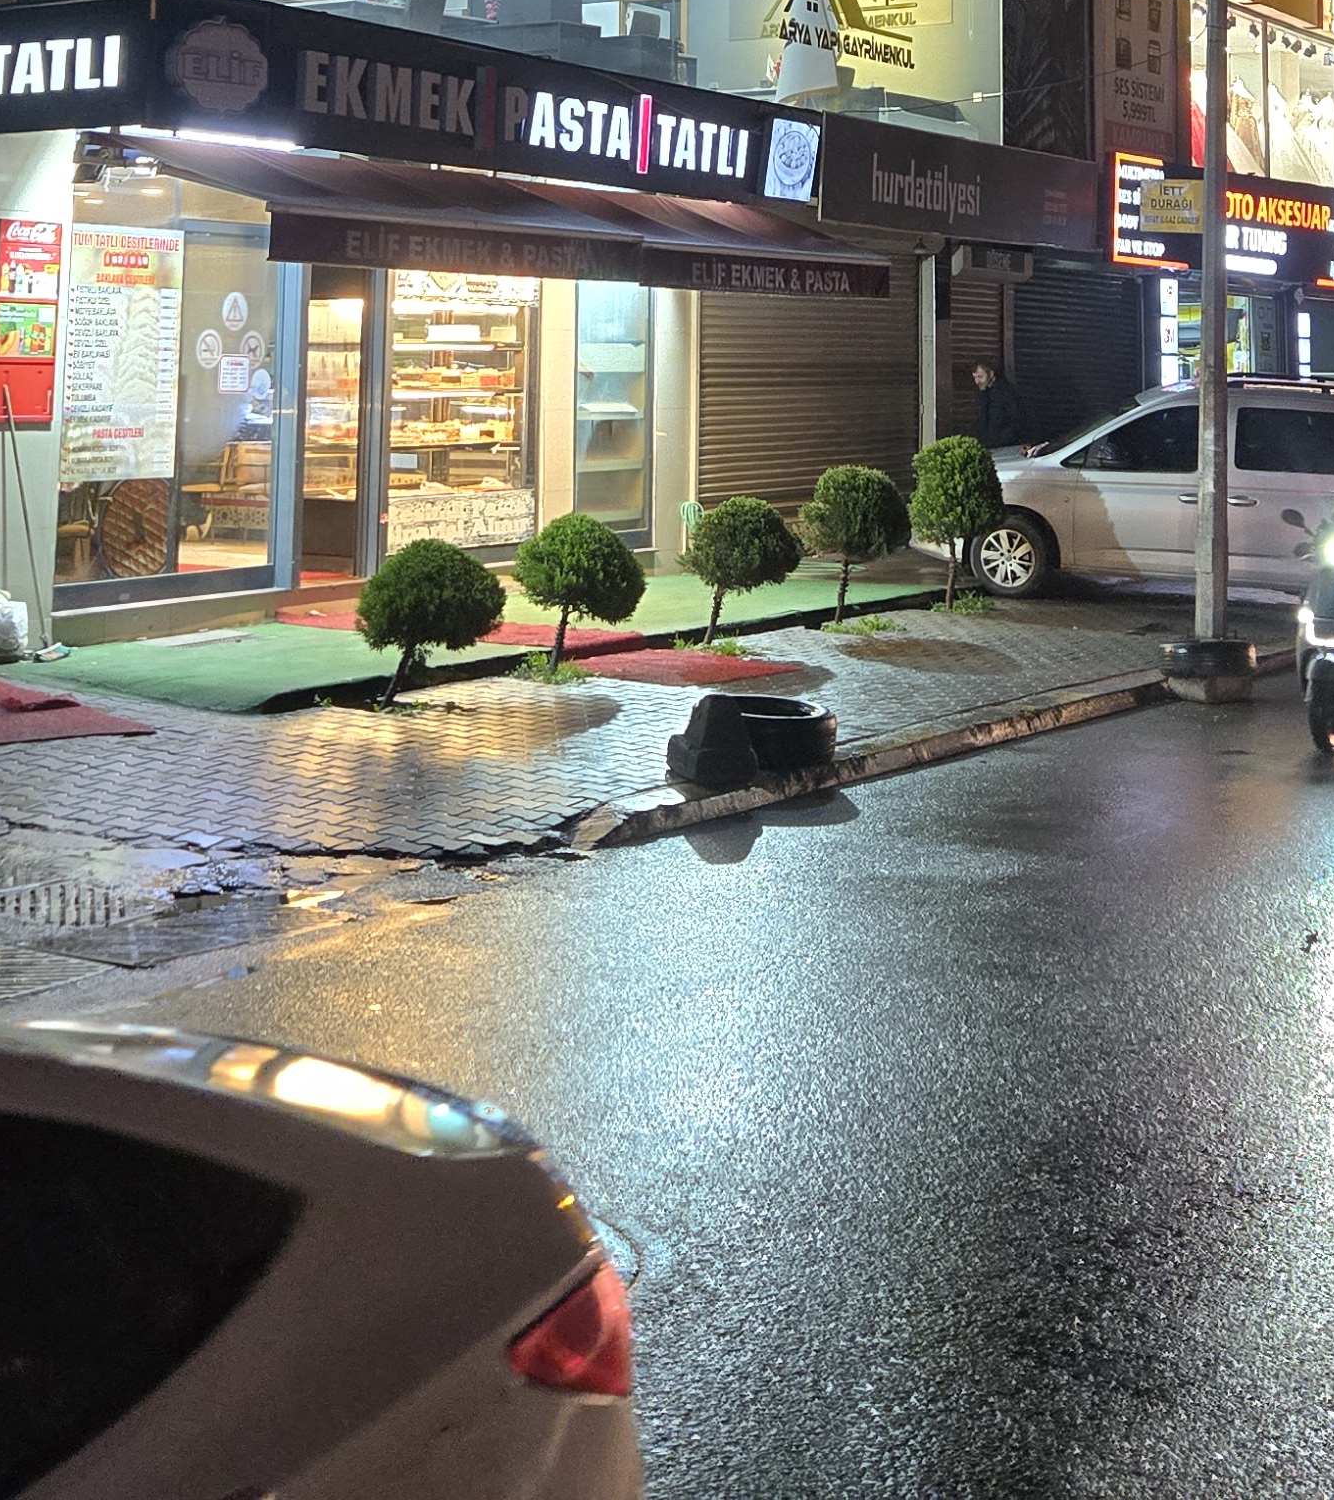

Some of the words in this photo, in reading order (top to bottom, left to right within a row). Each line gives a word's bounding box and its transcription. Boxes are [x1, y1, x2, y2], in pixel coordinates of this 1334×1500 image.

[779, 18, 812, 46] ARYA
[815, 27, 840, 52] YAPI
[843, 34, 915, 69] GAYRİMENKUL
[301, 49, 476, 136] EKMEK
[503, 86, 632, 161] PASTA
[655, 113, 749, 179] TATLI
[872, 152, 981, 224] hurdatölyesi
[1151, 197, 1192, 210] DURAĞI
[1159, 184, 1184, 196] İETT
[1257, 196, 1331, 231] AKSESUAR
[96, 233, 118, 248] TATLI
[409, 235, 494, 268] EKMEK
[692, 258, 726, 285] ELİF
[731, 263, 785, 288] EKMEK
[790, 269, 801, 290] &
[805, 269, 850, 294] PASTA
[93, 428, 112, 438] PASTA
